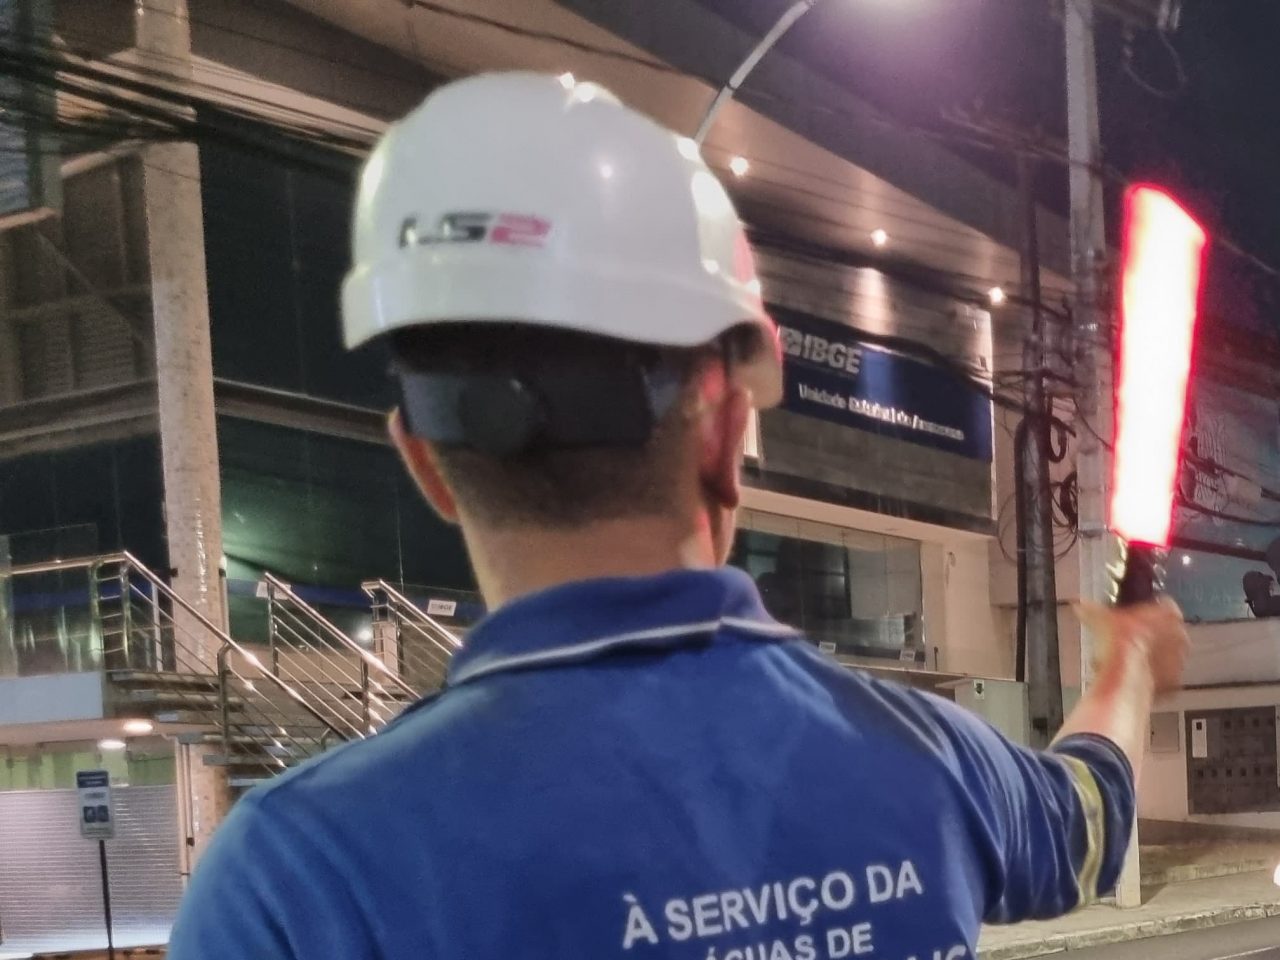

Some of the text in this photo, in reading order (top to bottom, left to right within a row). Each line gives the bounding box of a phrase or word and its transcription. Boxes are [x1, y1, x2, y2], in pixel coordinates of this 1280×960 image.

[803, 333, 862, 374] IBGE
[622, 860, 923, 949] À SERVIÇO DA
[828, 922, 874, 959] DE
